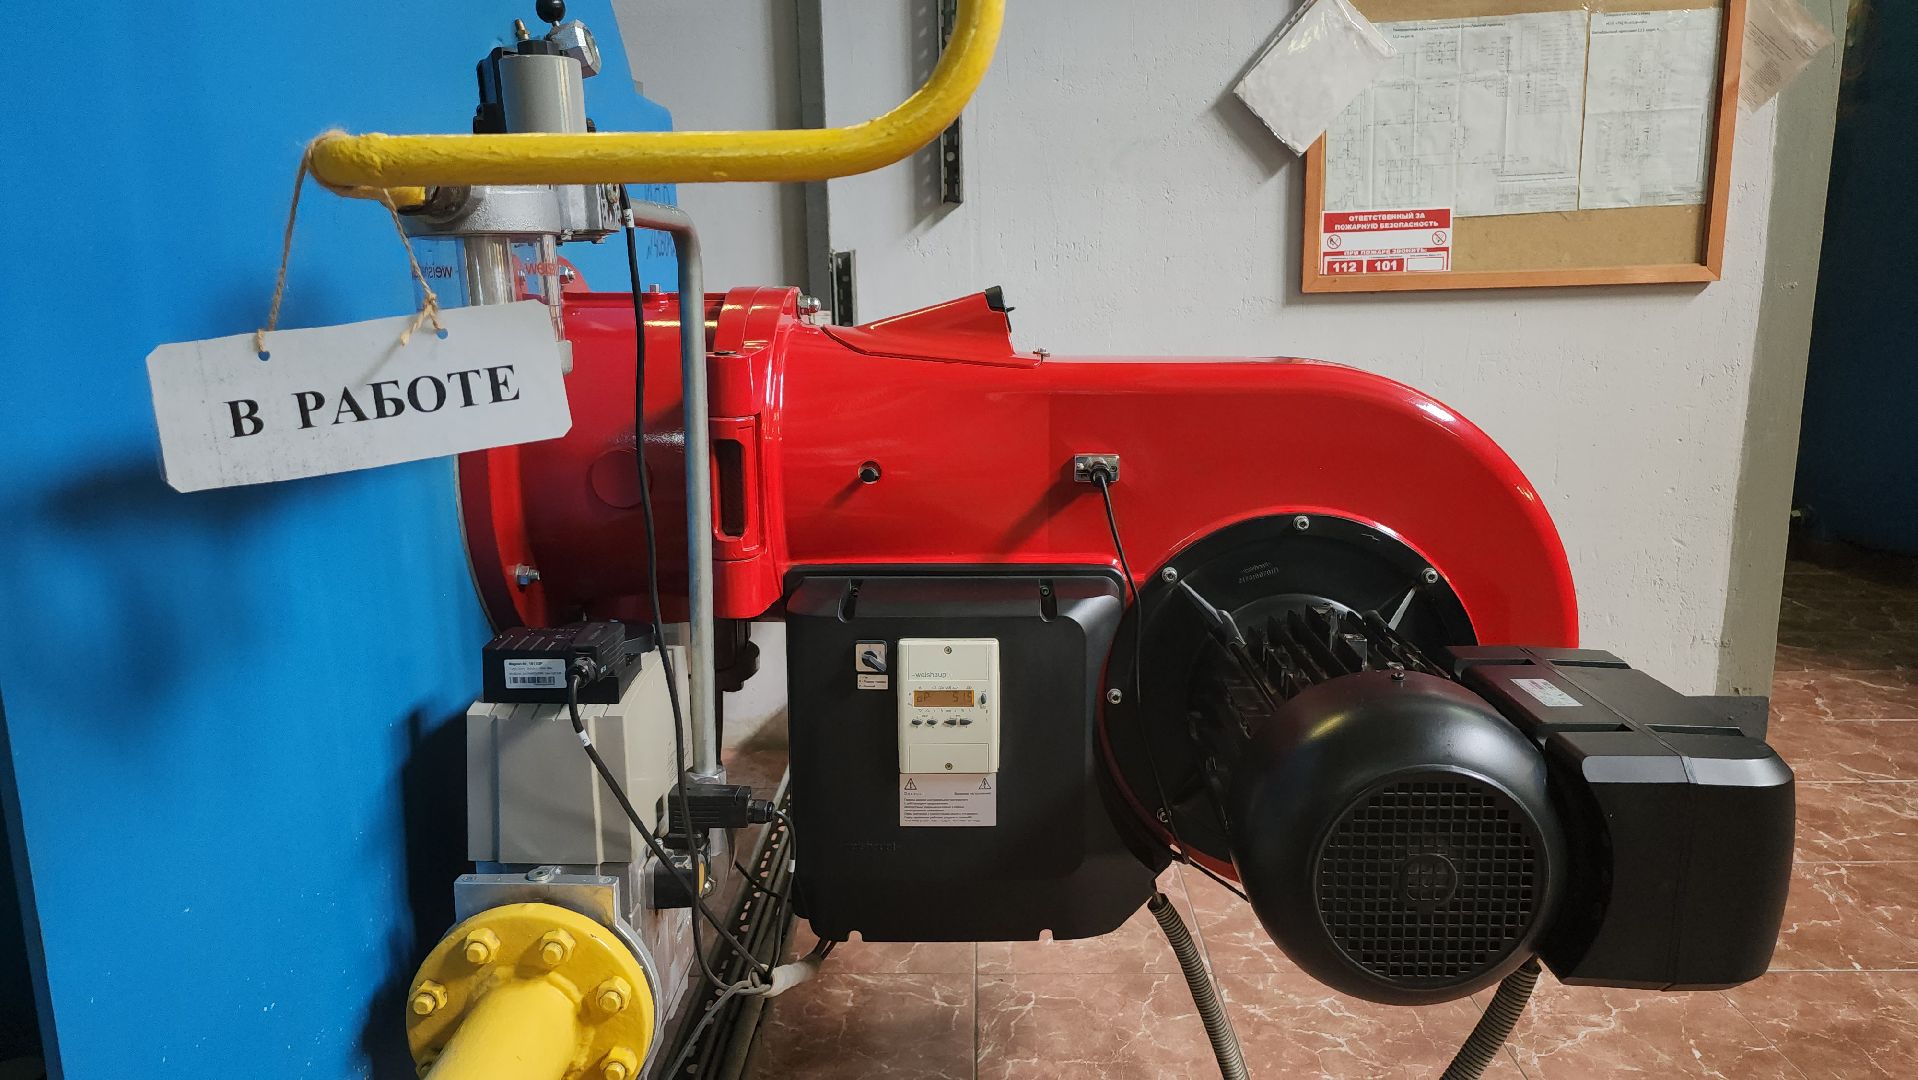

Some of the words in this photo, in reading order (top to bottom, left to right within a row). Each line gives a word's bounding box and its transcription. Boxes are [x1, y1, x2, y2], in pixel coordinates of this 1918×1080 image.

[1348, 211, 1415, 222] ОТВЕТСТВЕННЫЙ
[1334, 222, 1379, 231] ПОЖАРНУЮ
[1379, 221, 1439, 229] БЕЗОПАСНОСТЬ
[1333, 262, 1357, 273] 112
[1375, 260, 1397, 271] 101
[224, 399, 264, 439] В
[291, 364, 520, 430] РАБОТЕ
